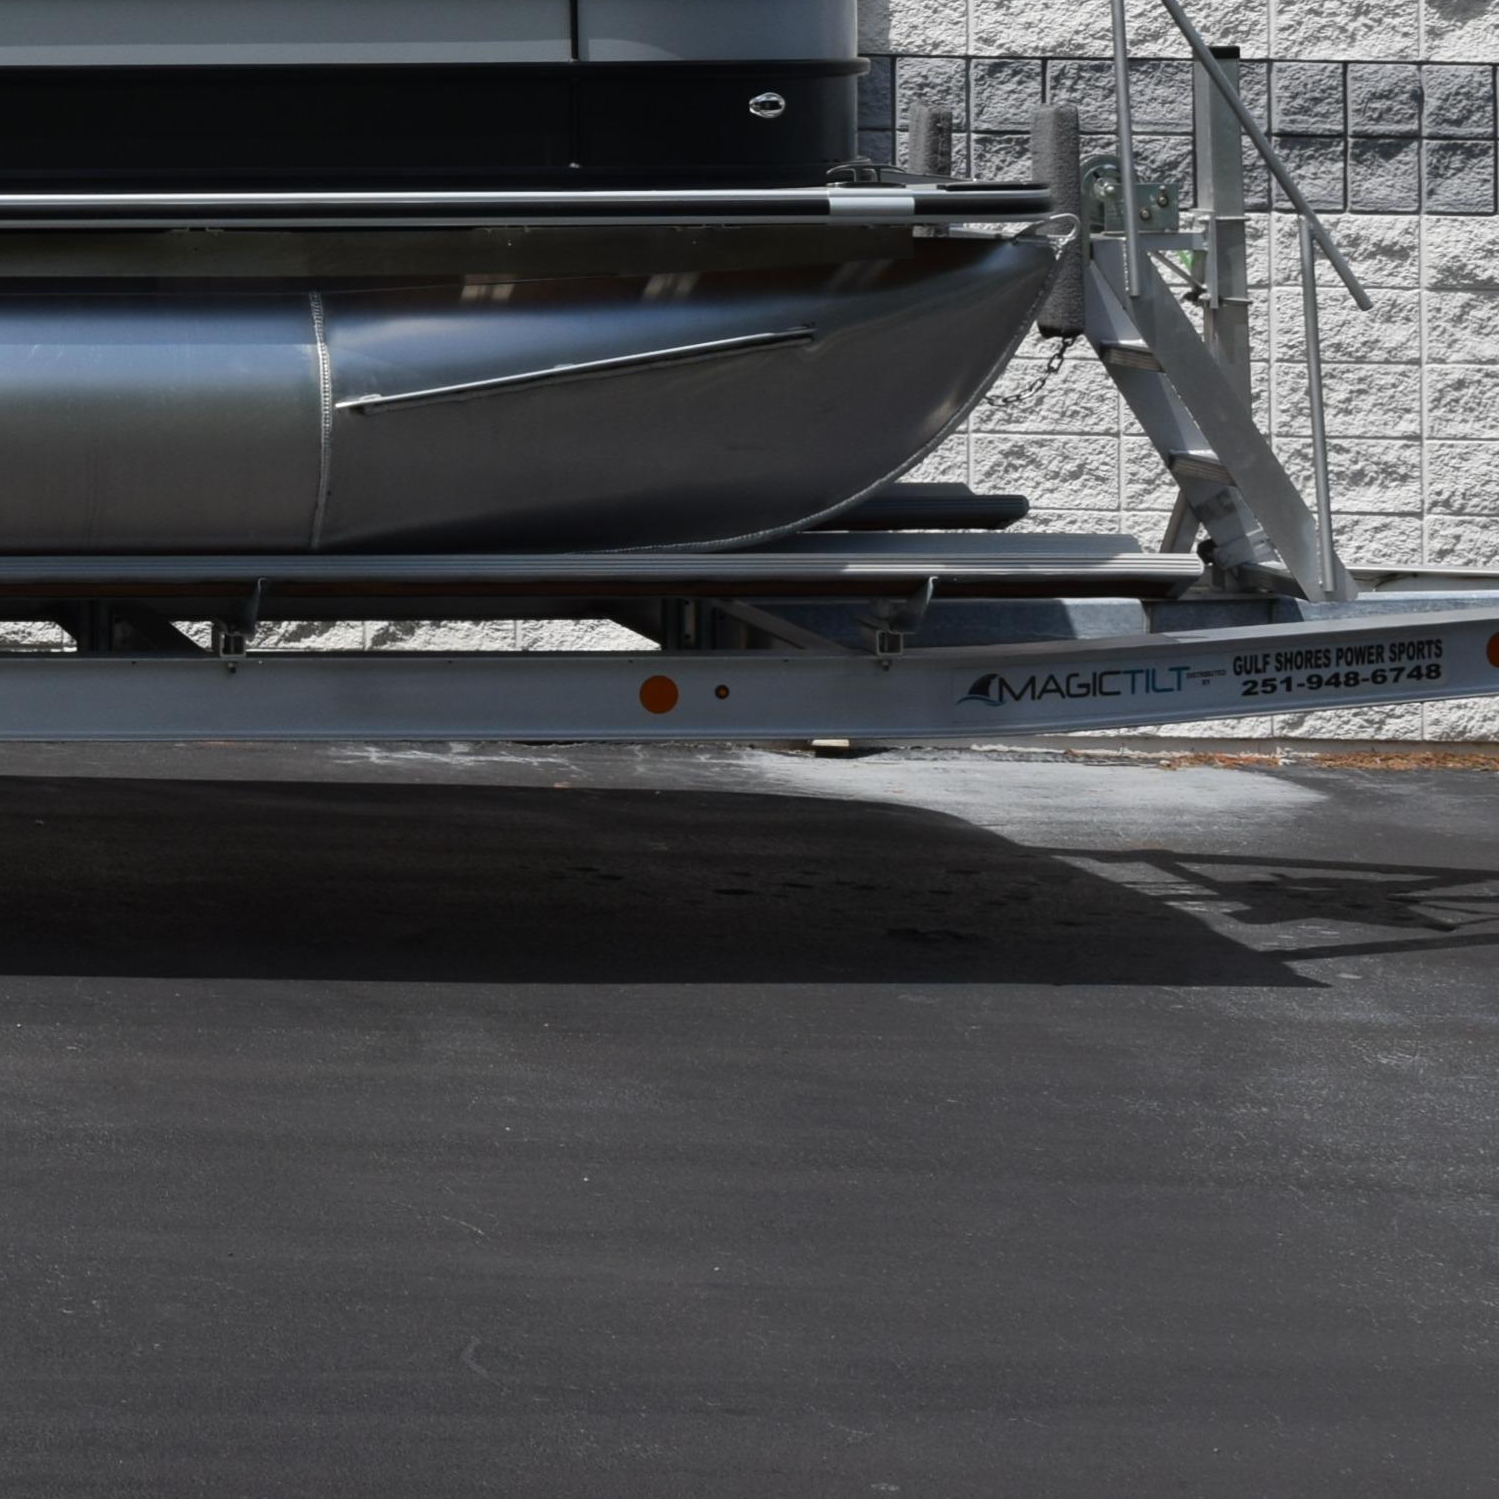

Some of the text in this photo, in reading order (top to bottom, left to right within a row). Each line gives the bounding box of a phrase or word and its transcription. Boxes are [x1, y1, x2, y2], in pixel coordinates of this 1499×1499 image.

[1233, 639, 1443, 676] GULF SHORES POWER SPORTS
[999, 666, 1191, 702] MAGICTILT
[1241, 663, 1442, 696] 251-948-6748
